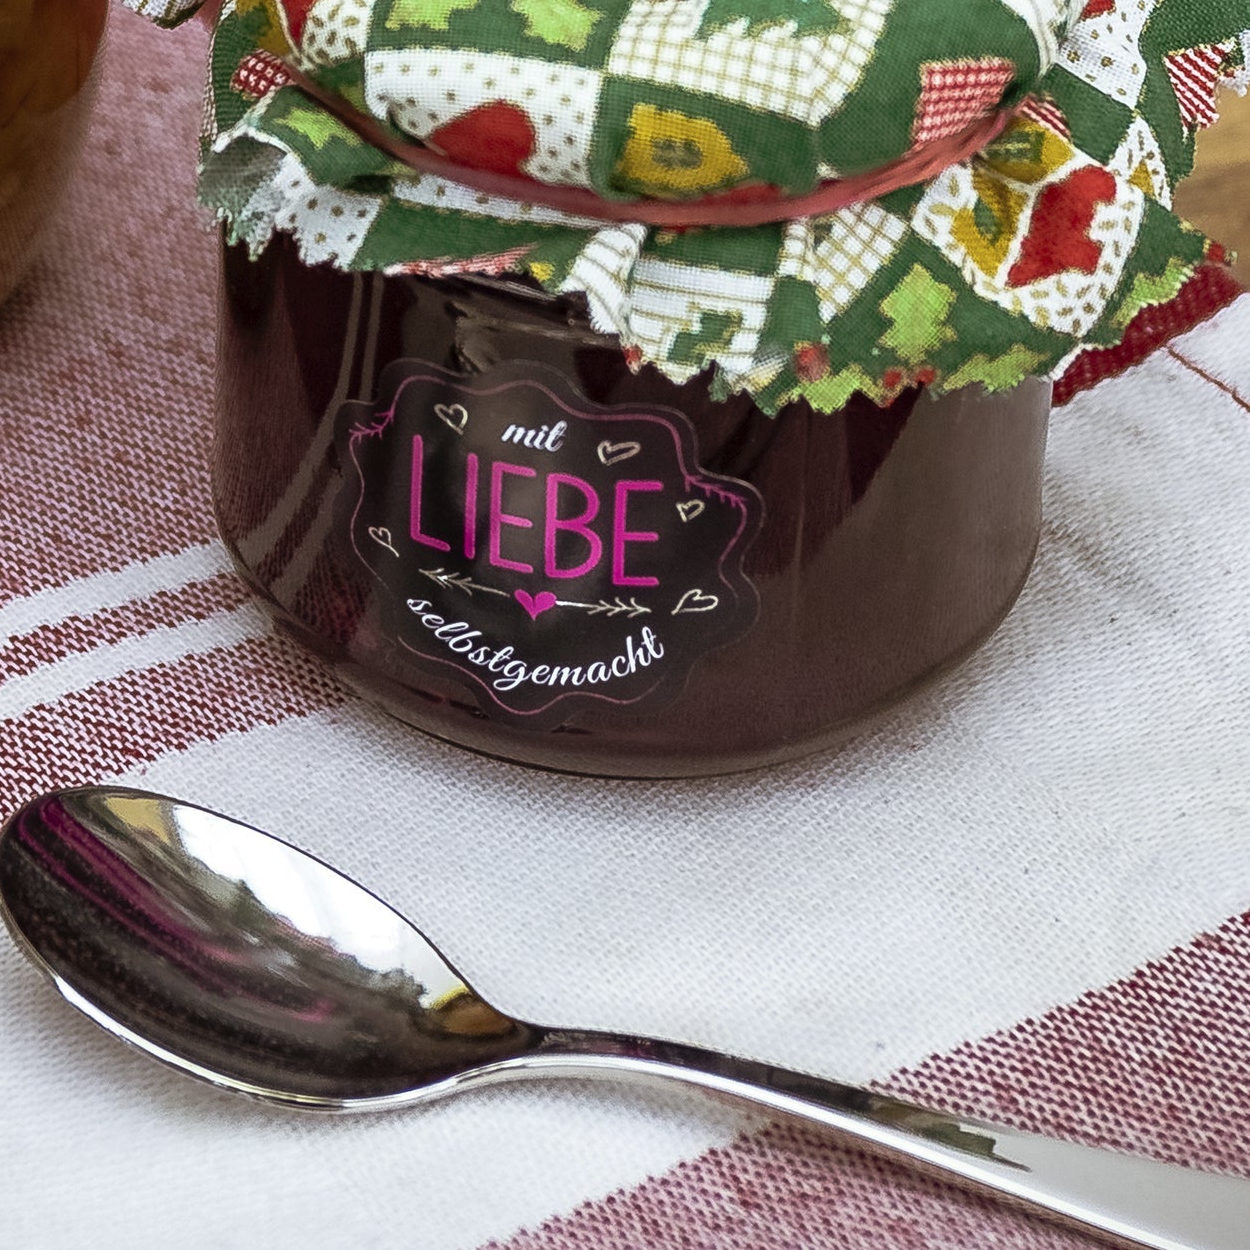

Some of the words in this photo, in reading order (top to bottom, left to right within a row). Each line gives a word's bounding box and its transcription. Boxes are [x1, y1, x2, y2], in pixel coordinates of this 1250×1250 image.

[501, 420, 568, 453] mit
[409, 434, 664, 588] LIEBE
[406, 597, 665, 692] selbstgemacht
